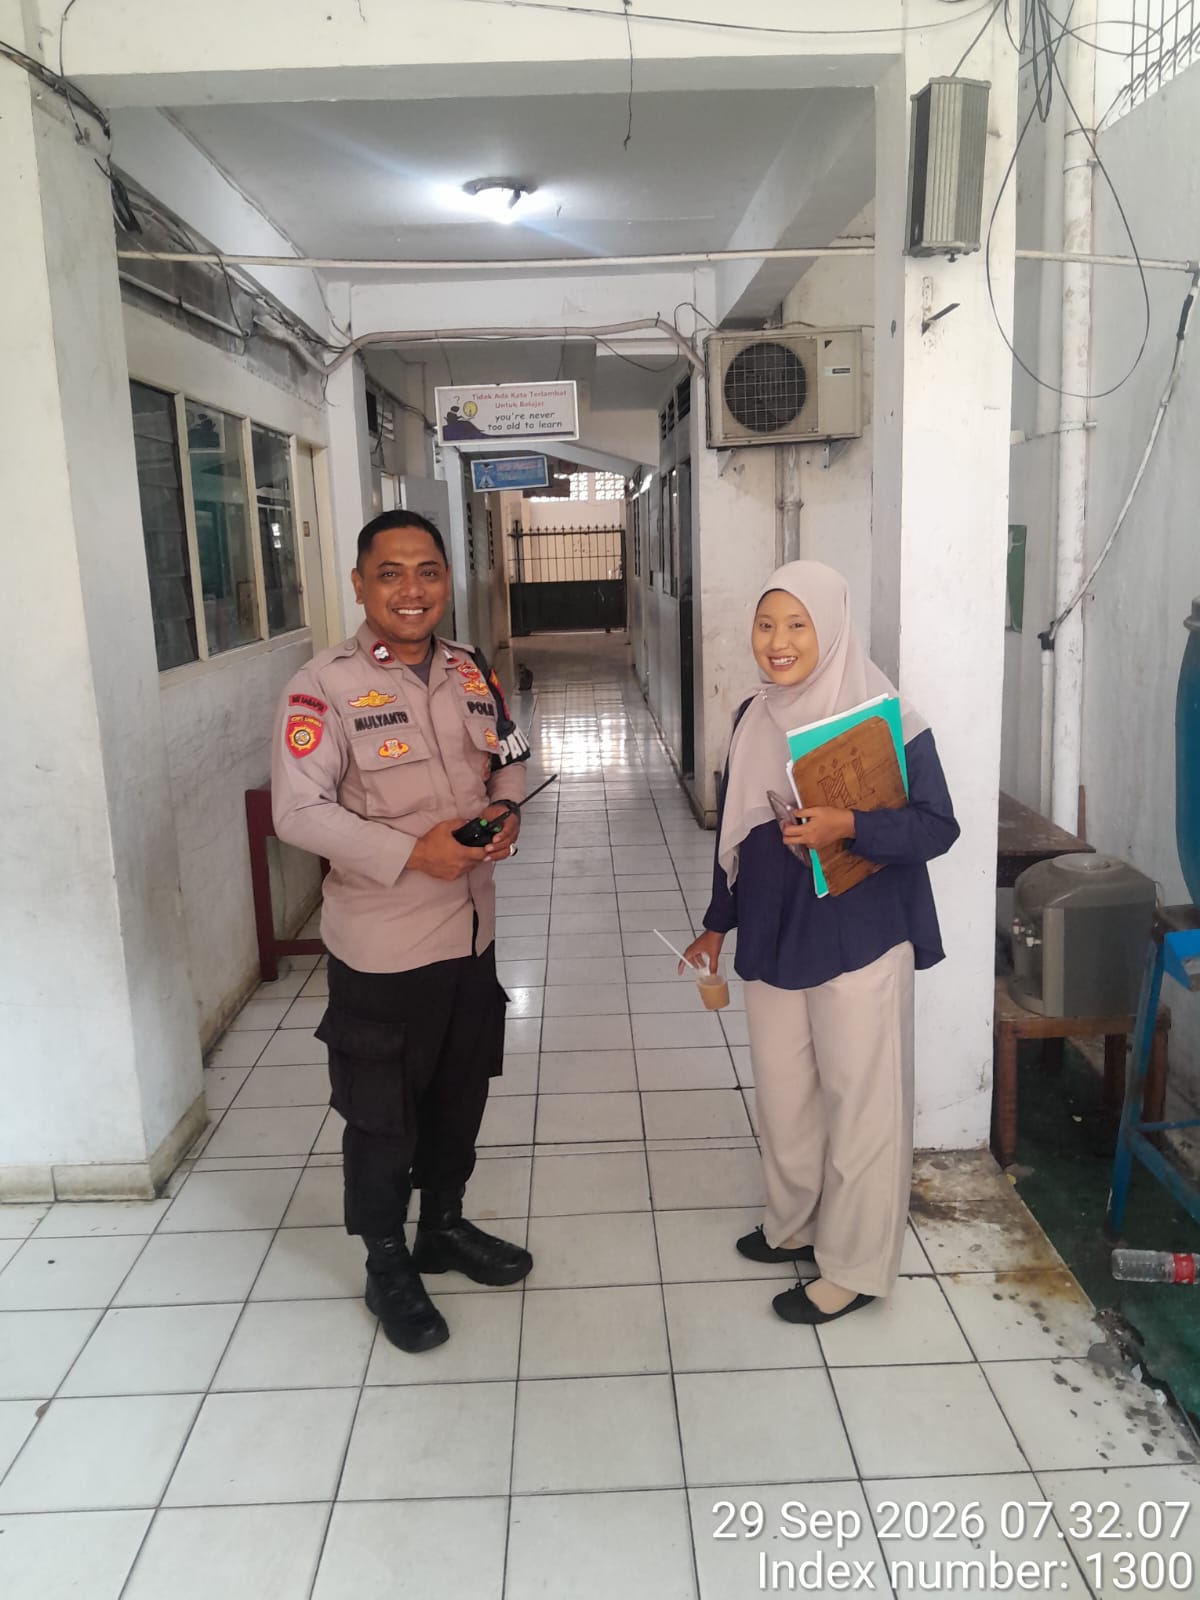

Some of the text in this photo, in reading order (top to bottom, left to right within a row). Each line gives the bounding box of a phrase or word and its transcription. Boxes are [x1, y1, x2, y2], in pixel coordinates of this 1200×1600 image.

[530, 390, 567, 398] Terlambat
[495, 412, 525, 423] you're
[506, 422, 520, 430] old
[539, 420, 562, 428] learn
[354, 711, 409, 732] MULYANTO
